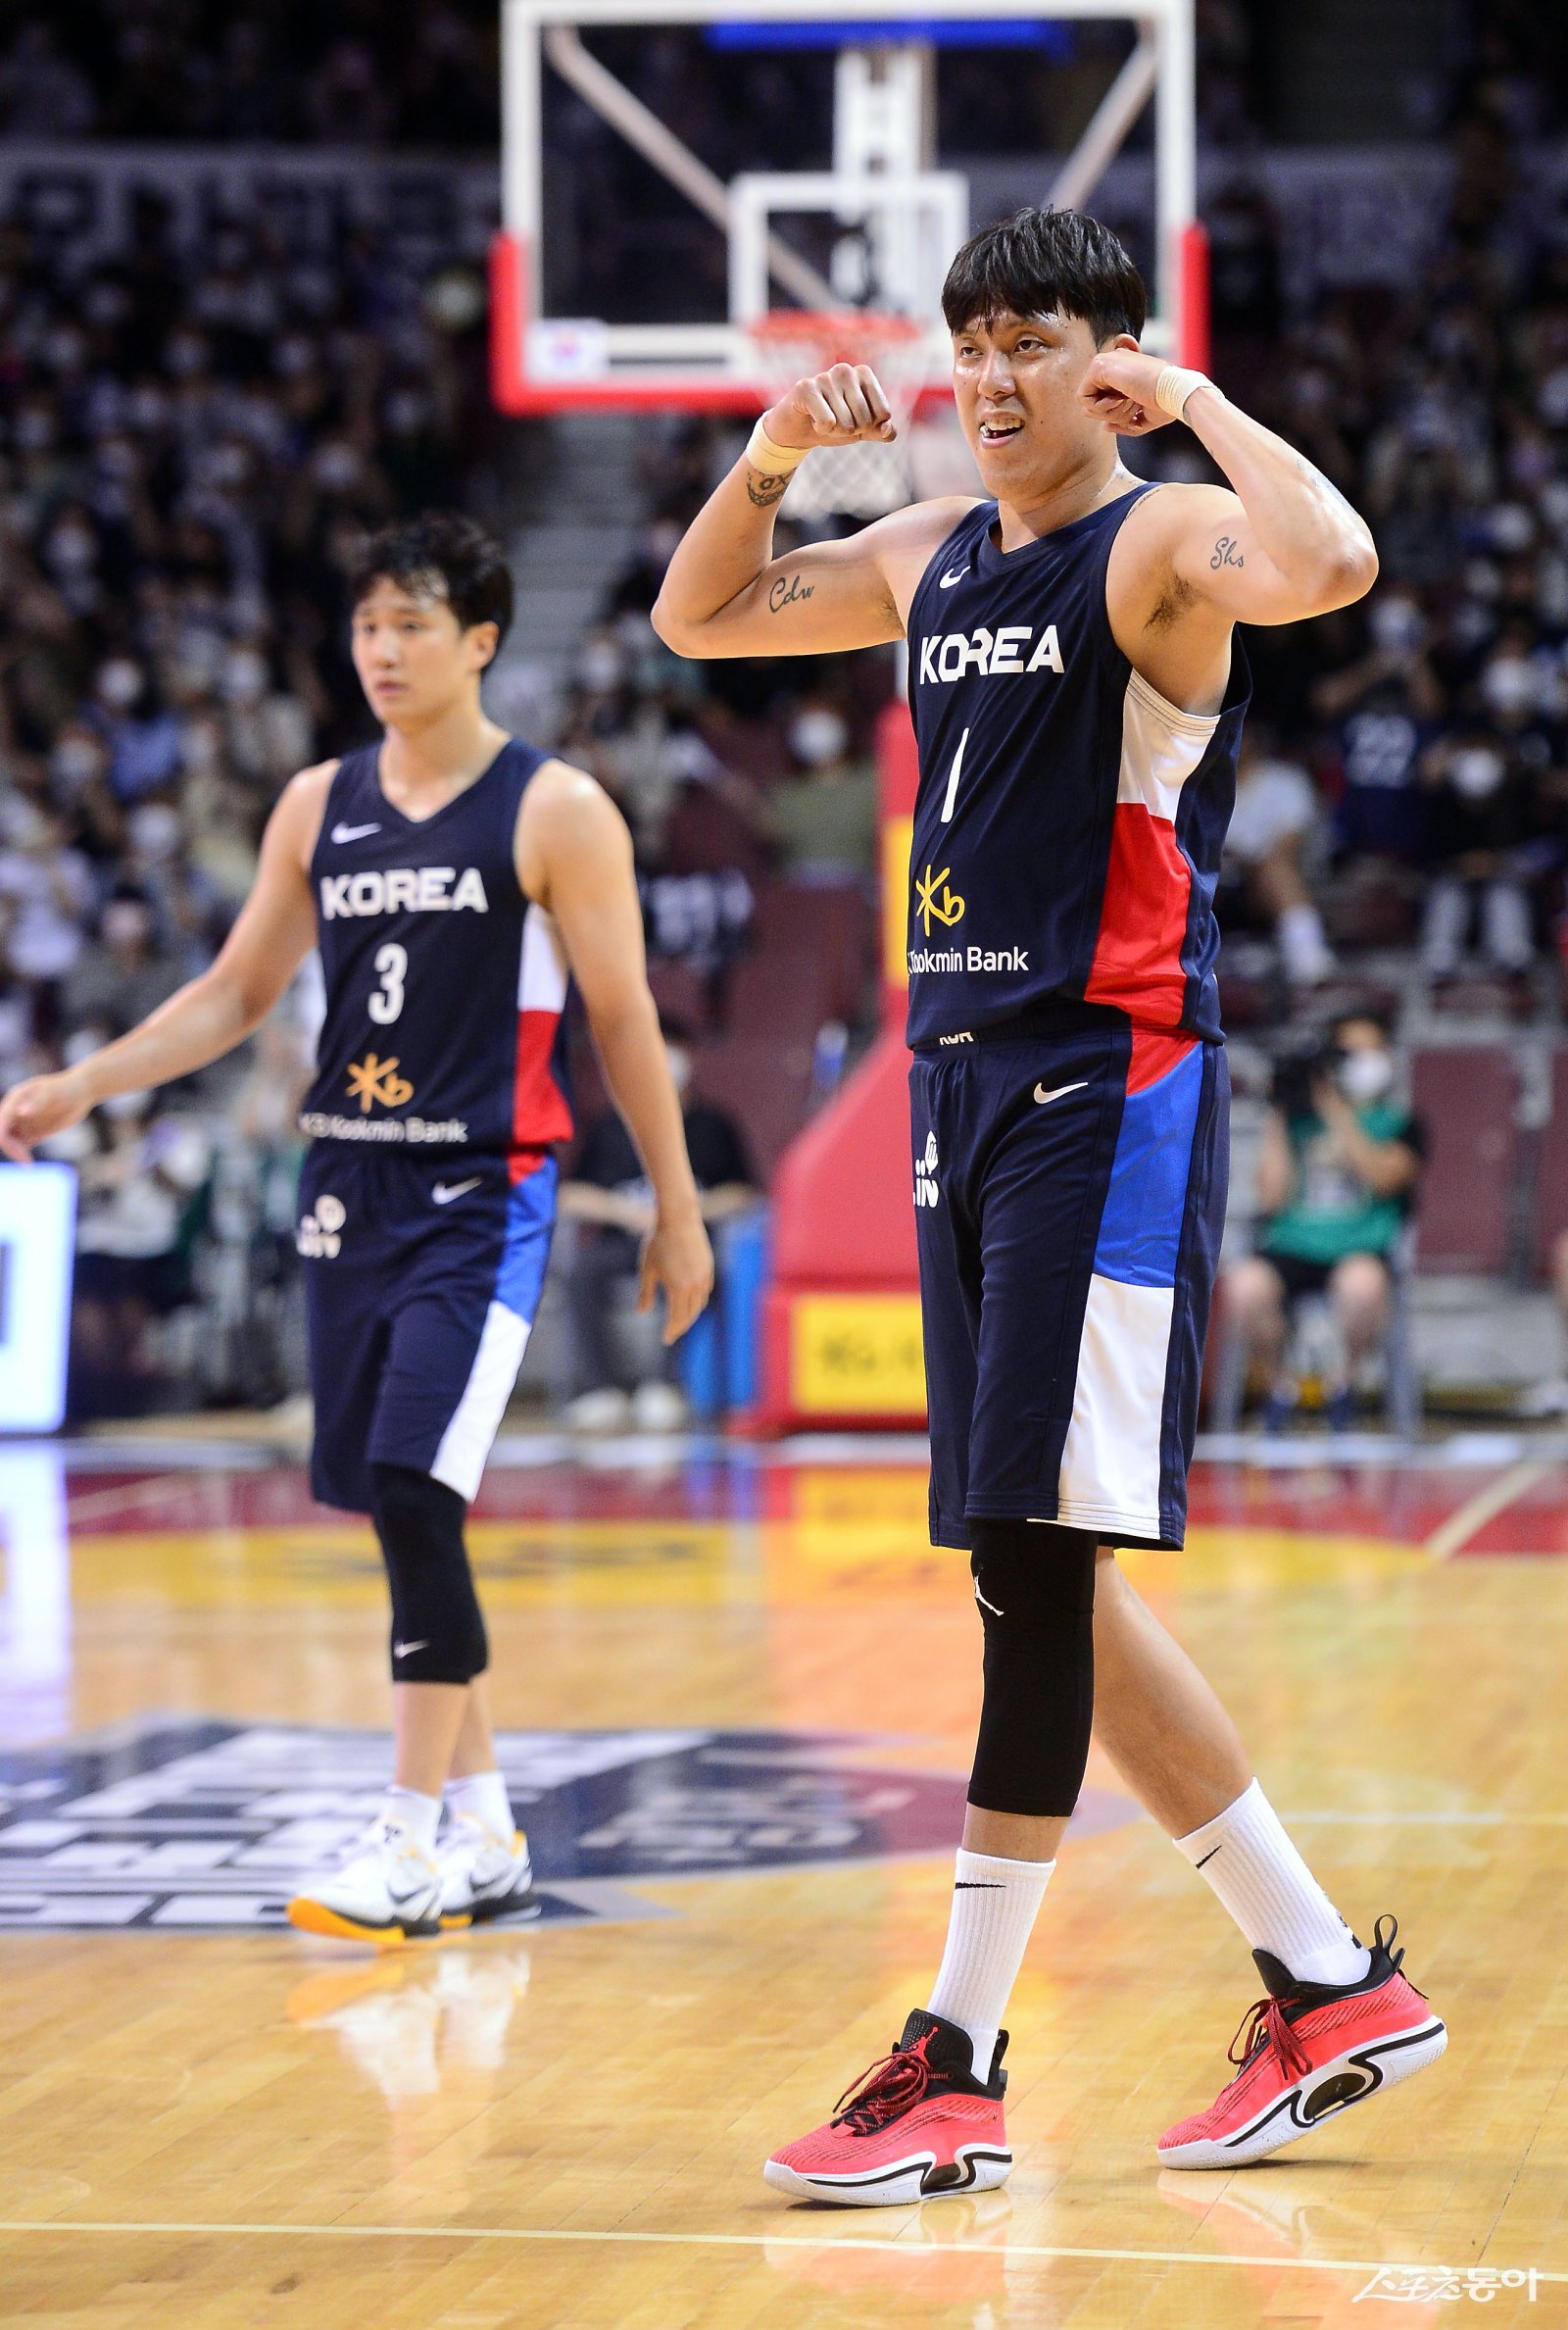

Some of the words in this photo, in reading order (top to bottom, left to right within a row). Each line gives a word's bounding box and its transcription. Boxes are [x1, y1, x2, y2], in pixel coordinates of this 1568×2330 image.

[919, 624, 1065, 685] KOREA
[940, 726, 970, 823] 1
[319, 867, 489, 920] KOREA
[367, 942, 409, 1025] 3
[966, 946, 1029, 972] Bank
[329, 1114, 405, 1142] Kookmin
[406, 1115, 468, 1144] Bank
